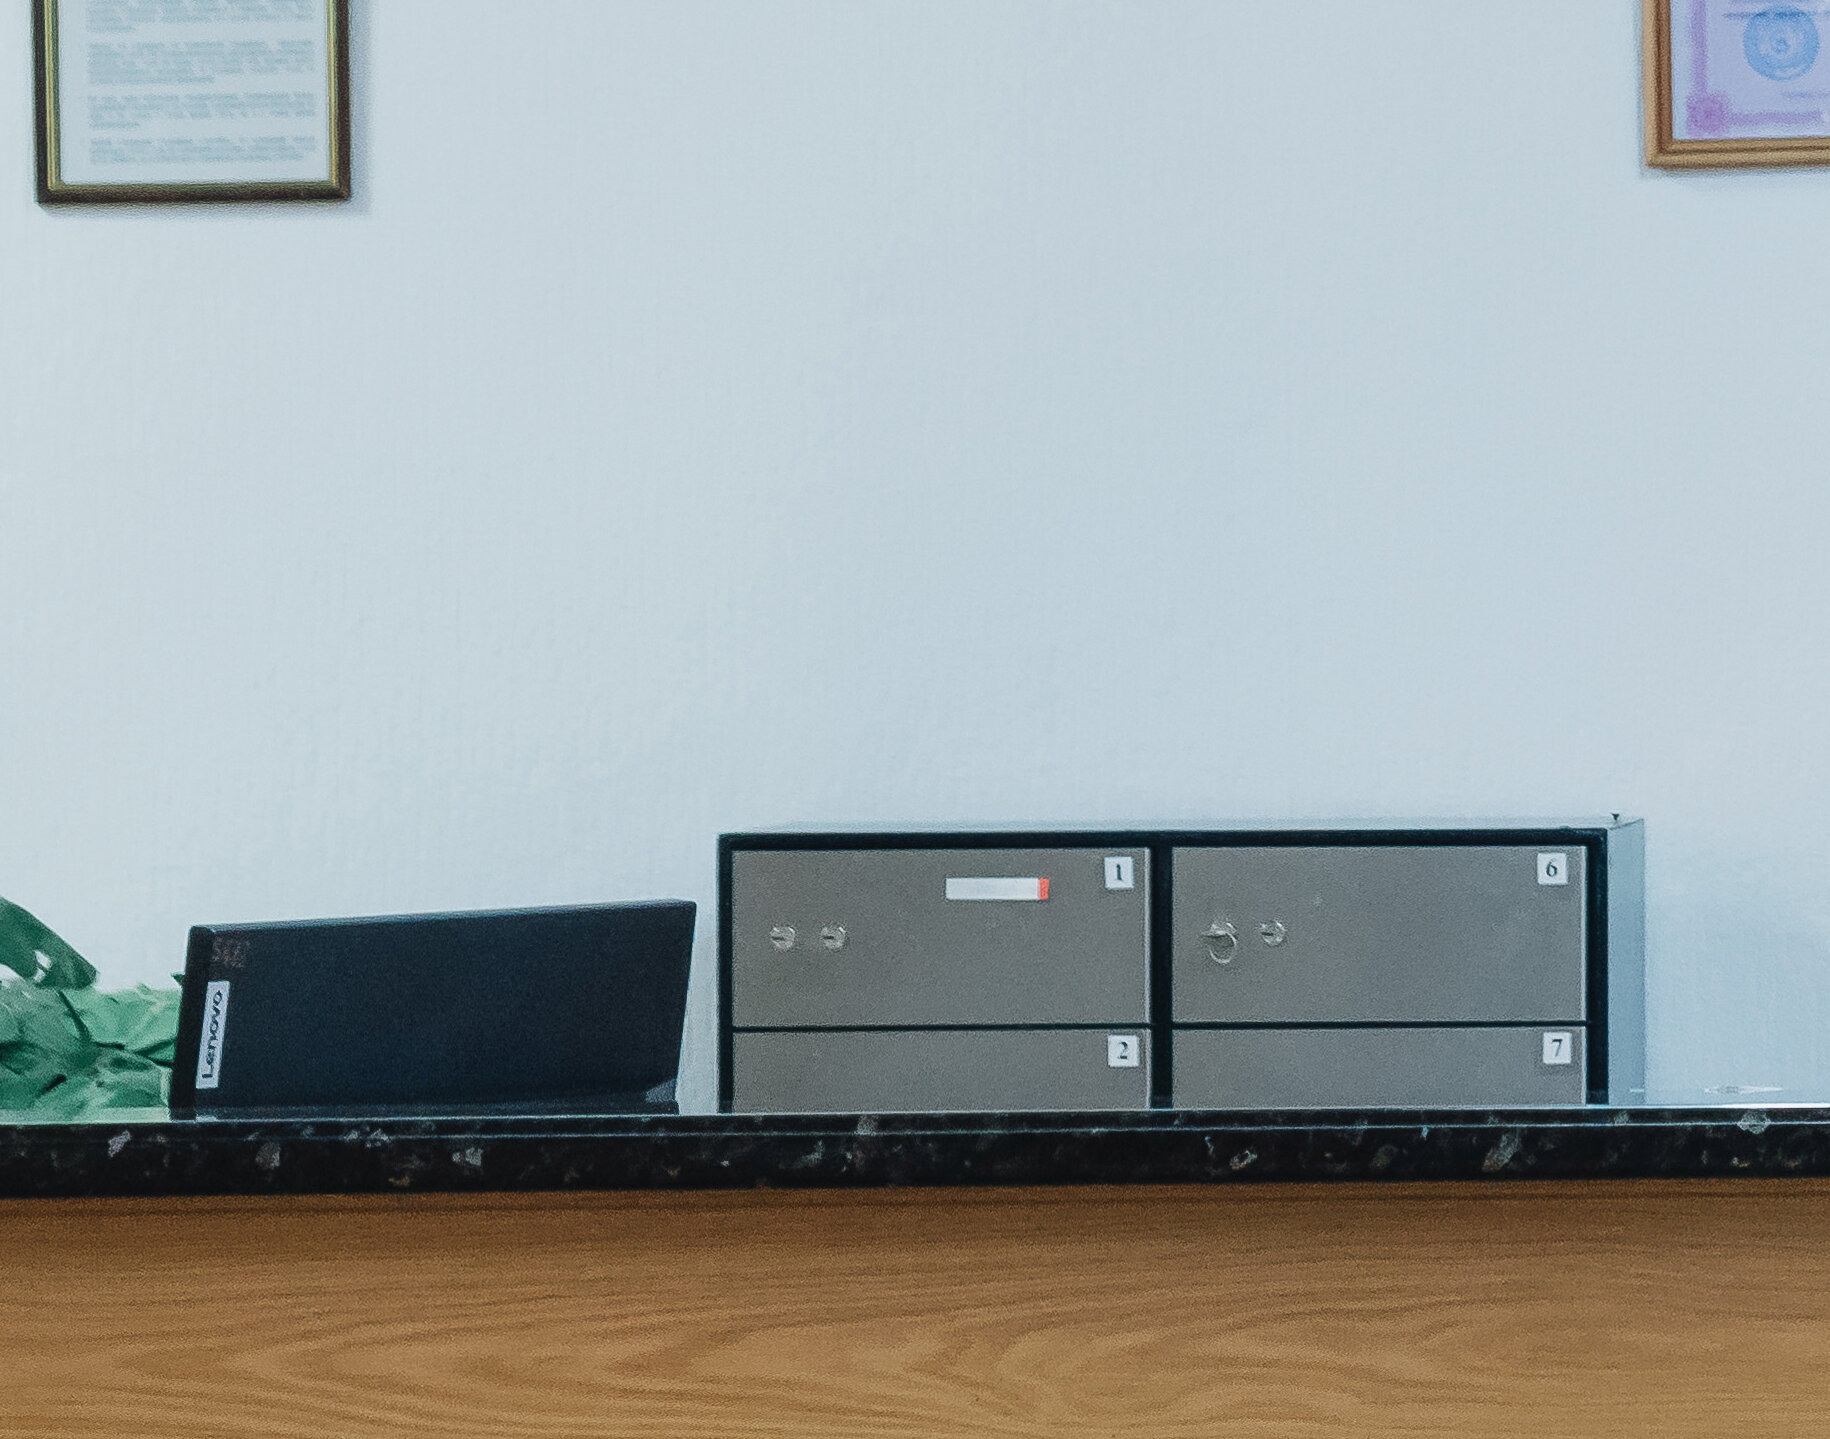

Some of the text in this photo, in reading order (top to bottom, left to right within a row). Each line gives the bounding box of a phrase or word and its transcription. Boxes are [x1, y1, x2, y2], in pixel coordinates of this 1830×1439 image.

[1115, 863, 1123, 881] 1
[1545, 858, 1558, 878] 6
[201, 990, 223, 1079] Lenovo
[1116, 1040, 1130, 1060] 2
[1550, 1037, 1564, 1058] 7
